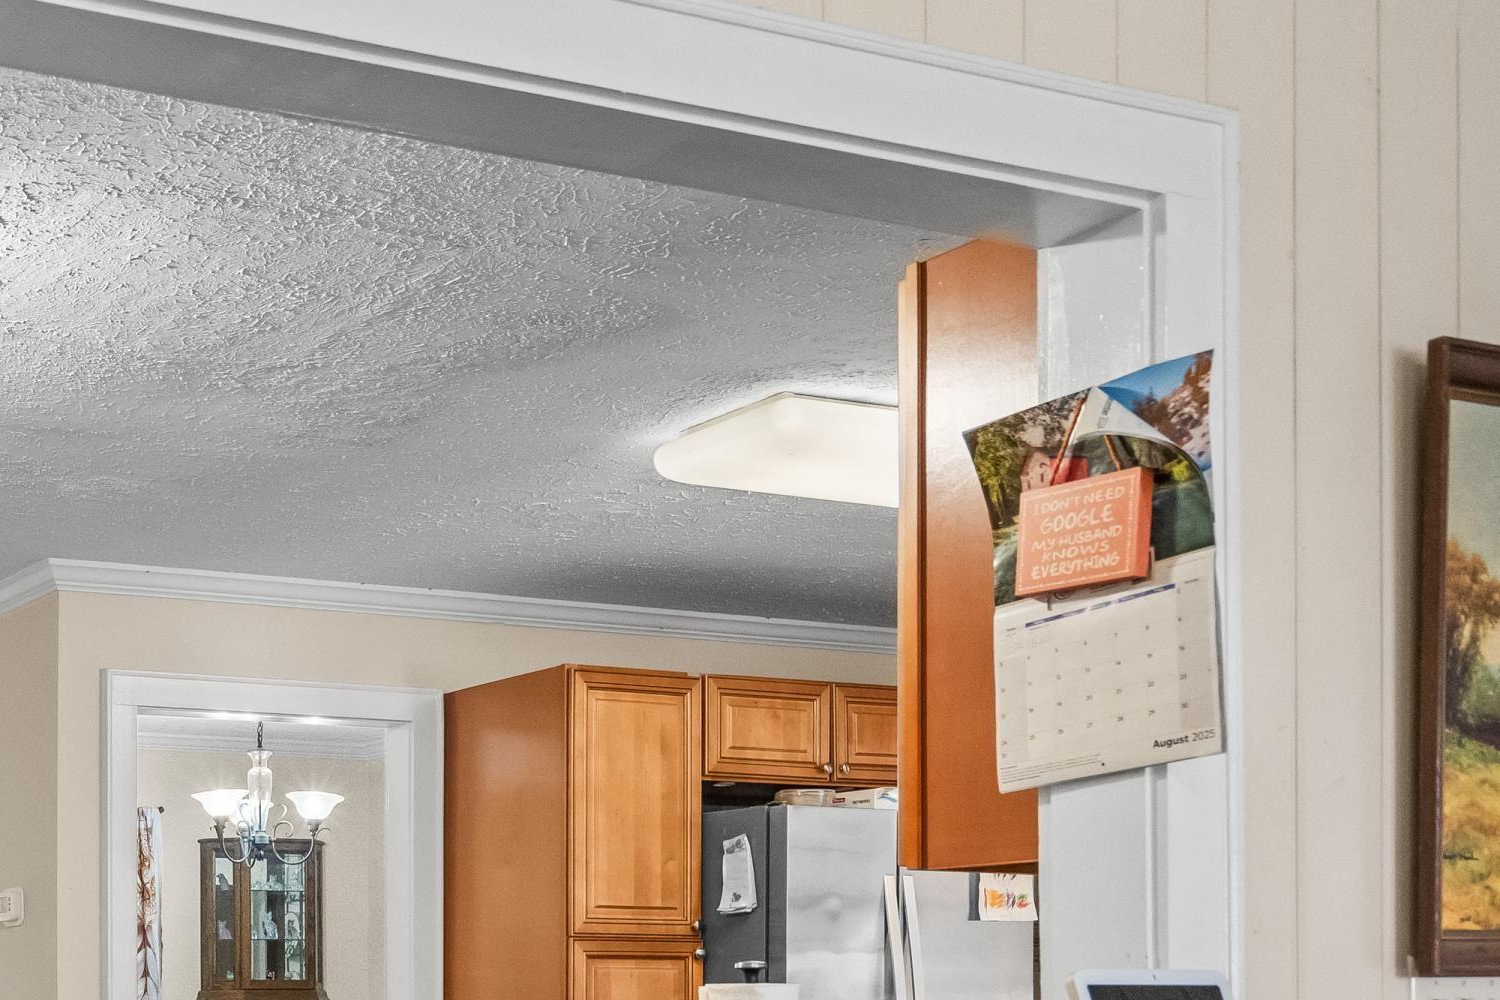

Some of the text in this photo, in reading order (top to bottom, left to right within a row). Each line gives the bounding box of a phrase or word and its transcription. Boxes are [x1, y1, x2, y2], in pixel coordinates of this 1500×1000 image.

[1034, 486, 1125, 516] I DON'T NEED
[1040, 504, 1115, 535] GOOGLE
[1031, 525, 1123, 553] MY HUSBAND
[1042, 540, 1110, 563] KNOWS
[1031, 552, 1120, 580] EVERYTHING
[1153, 729, 1216, 749] August 2025
